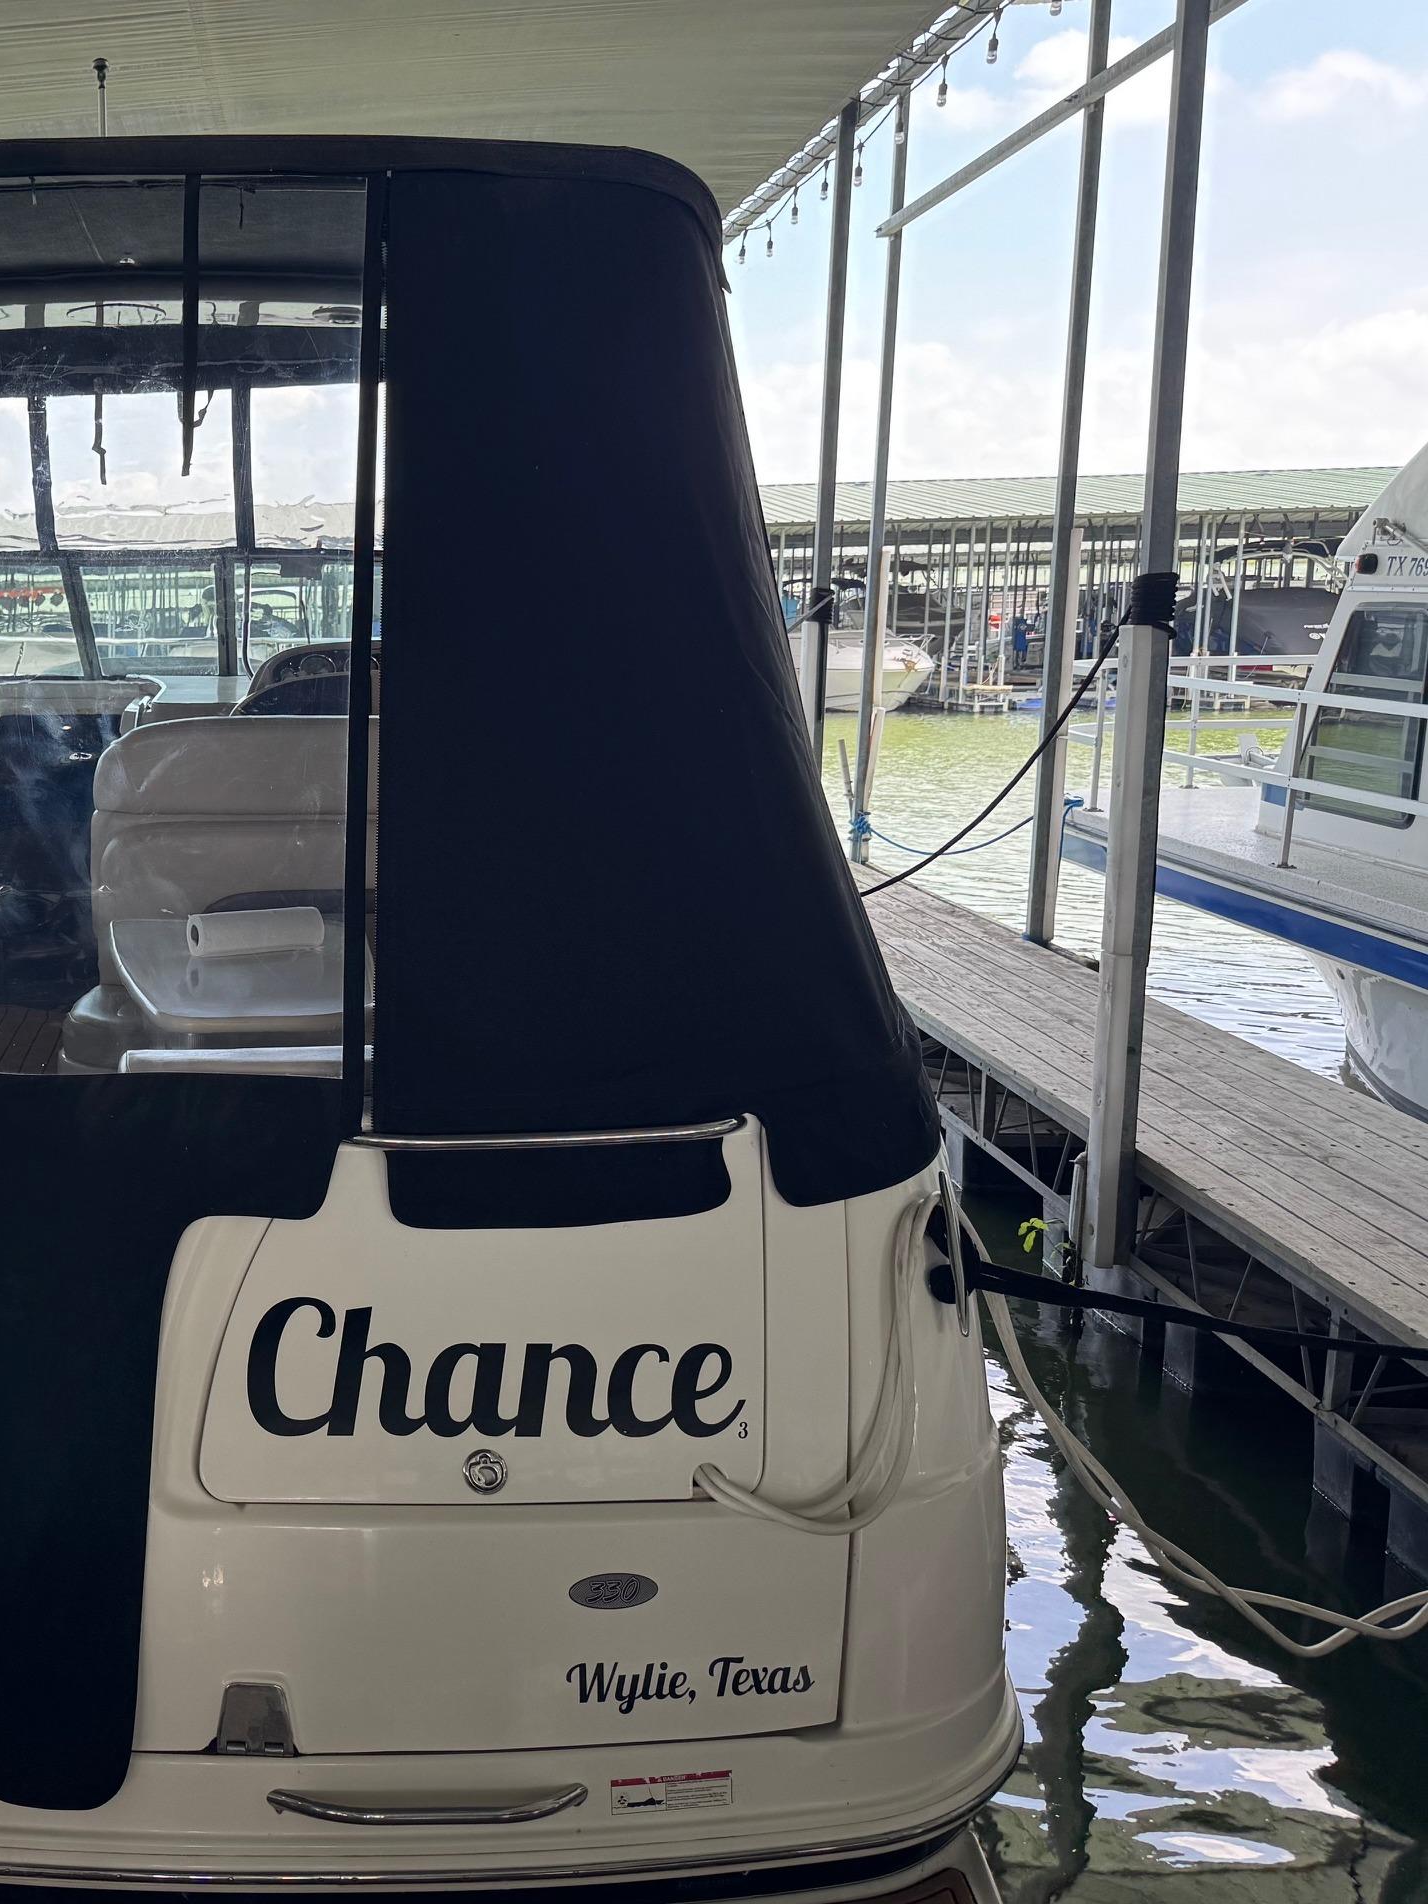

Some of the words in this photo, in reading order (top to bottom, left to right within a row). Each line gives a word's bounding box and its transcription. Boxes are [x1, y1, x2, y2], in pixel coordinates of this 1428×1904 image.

[1387, 556, 1408, 576] TX
[246, 1296, 747, 1438] Chance
[737, 1421, 748, 1439] 3
[586, 1577, 640, 1604] 330
[565, 1661, 697, 1715] Wylie,
[708, 1656, 816, 1698] Texas
